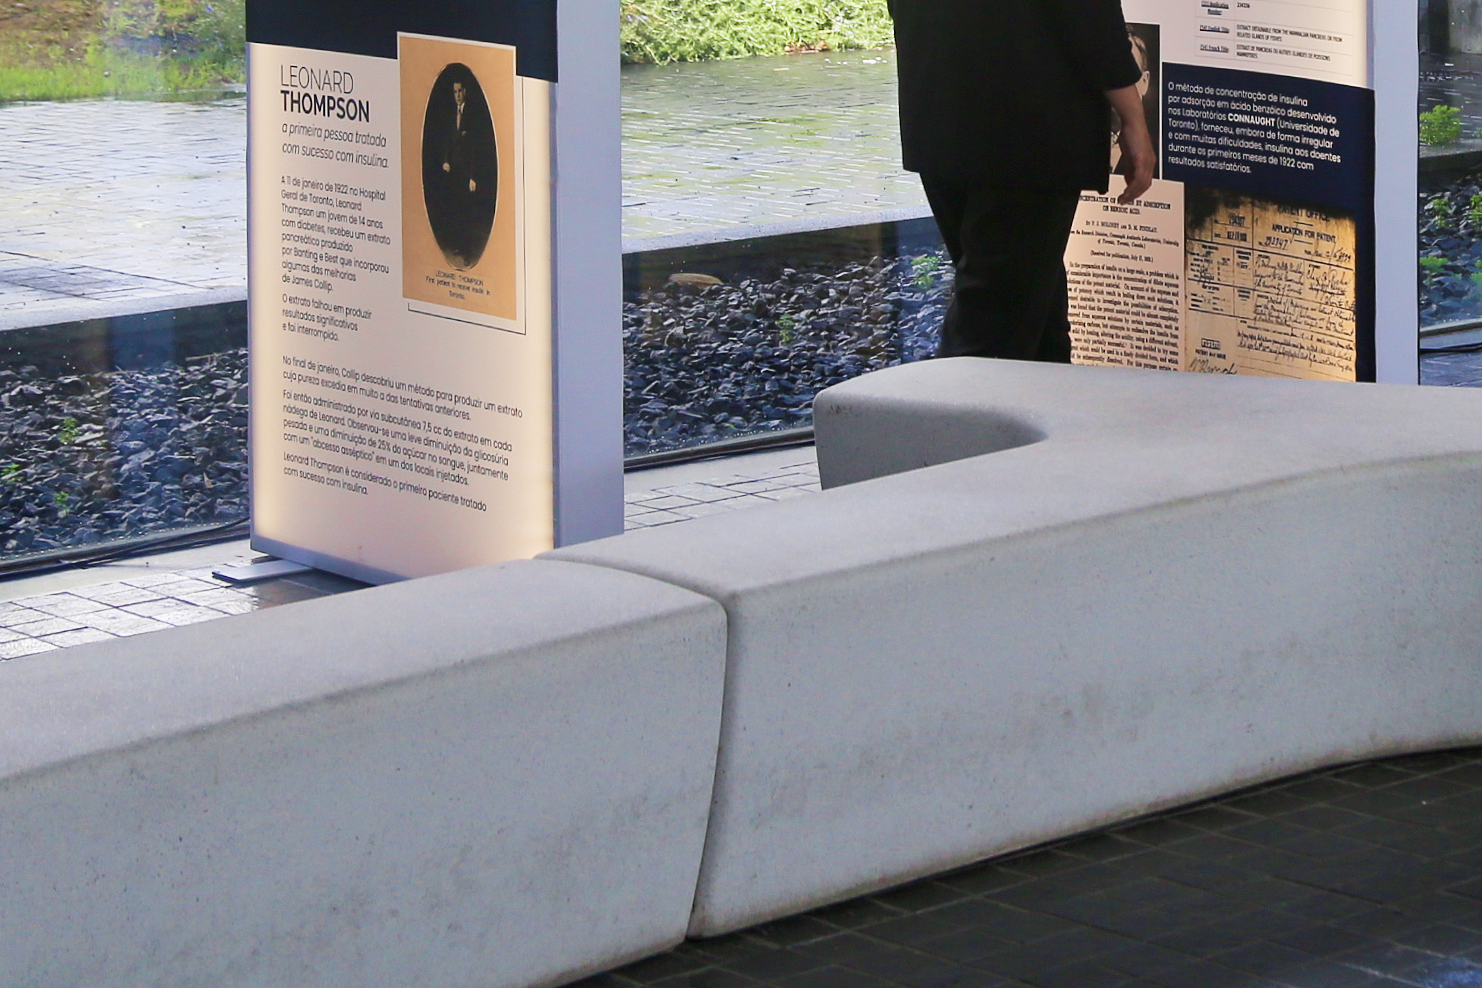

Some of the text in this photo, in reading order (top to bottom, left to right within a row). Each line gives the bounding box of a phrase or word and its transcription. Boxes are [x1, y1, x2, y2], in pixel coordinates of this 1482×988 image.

[280, 65, 353, 94] LEONARD
[281, 90, 370, 123] THOMPSON
[281, 123, 386, 147] a primeira pessoa tratada
[1168, 107, 1339, 137] nos Laboratórios CONNAUGHT (Universidade de
[282, 143, 388, 168] com sucesso com insulina.
